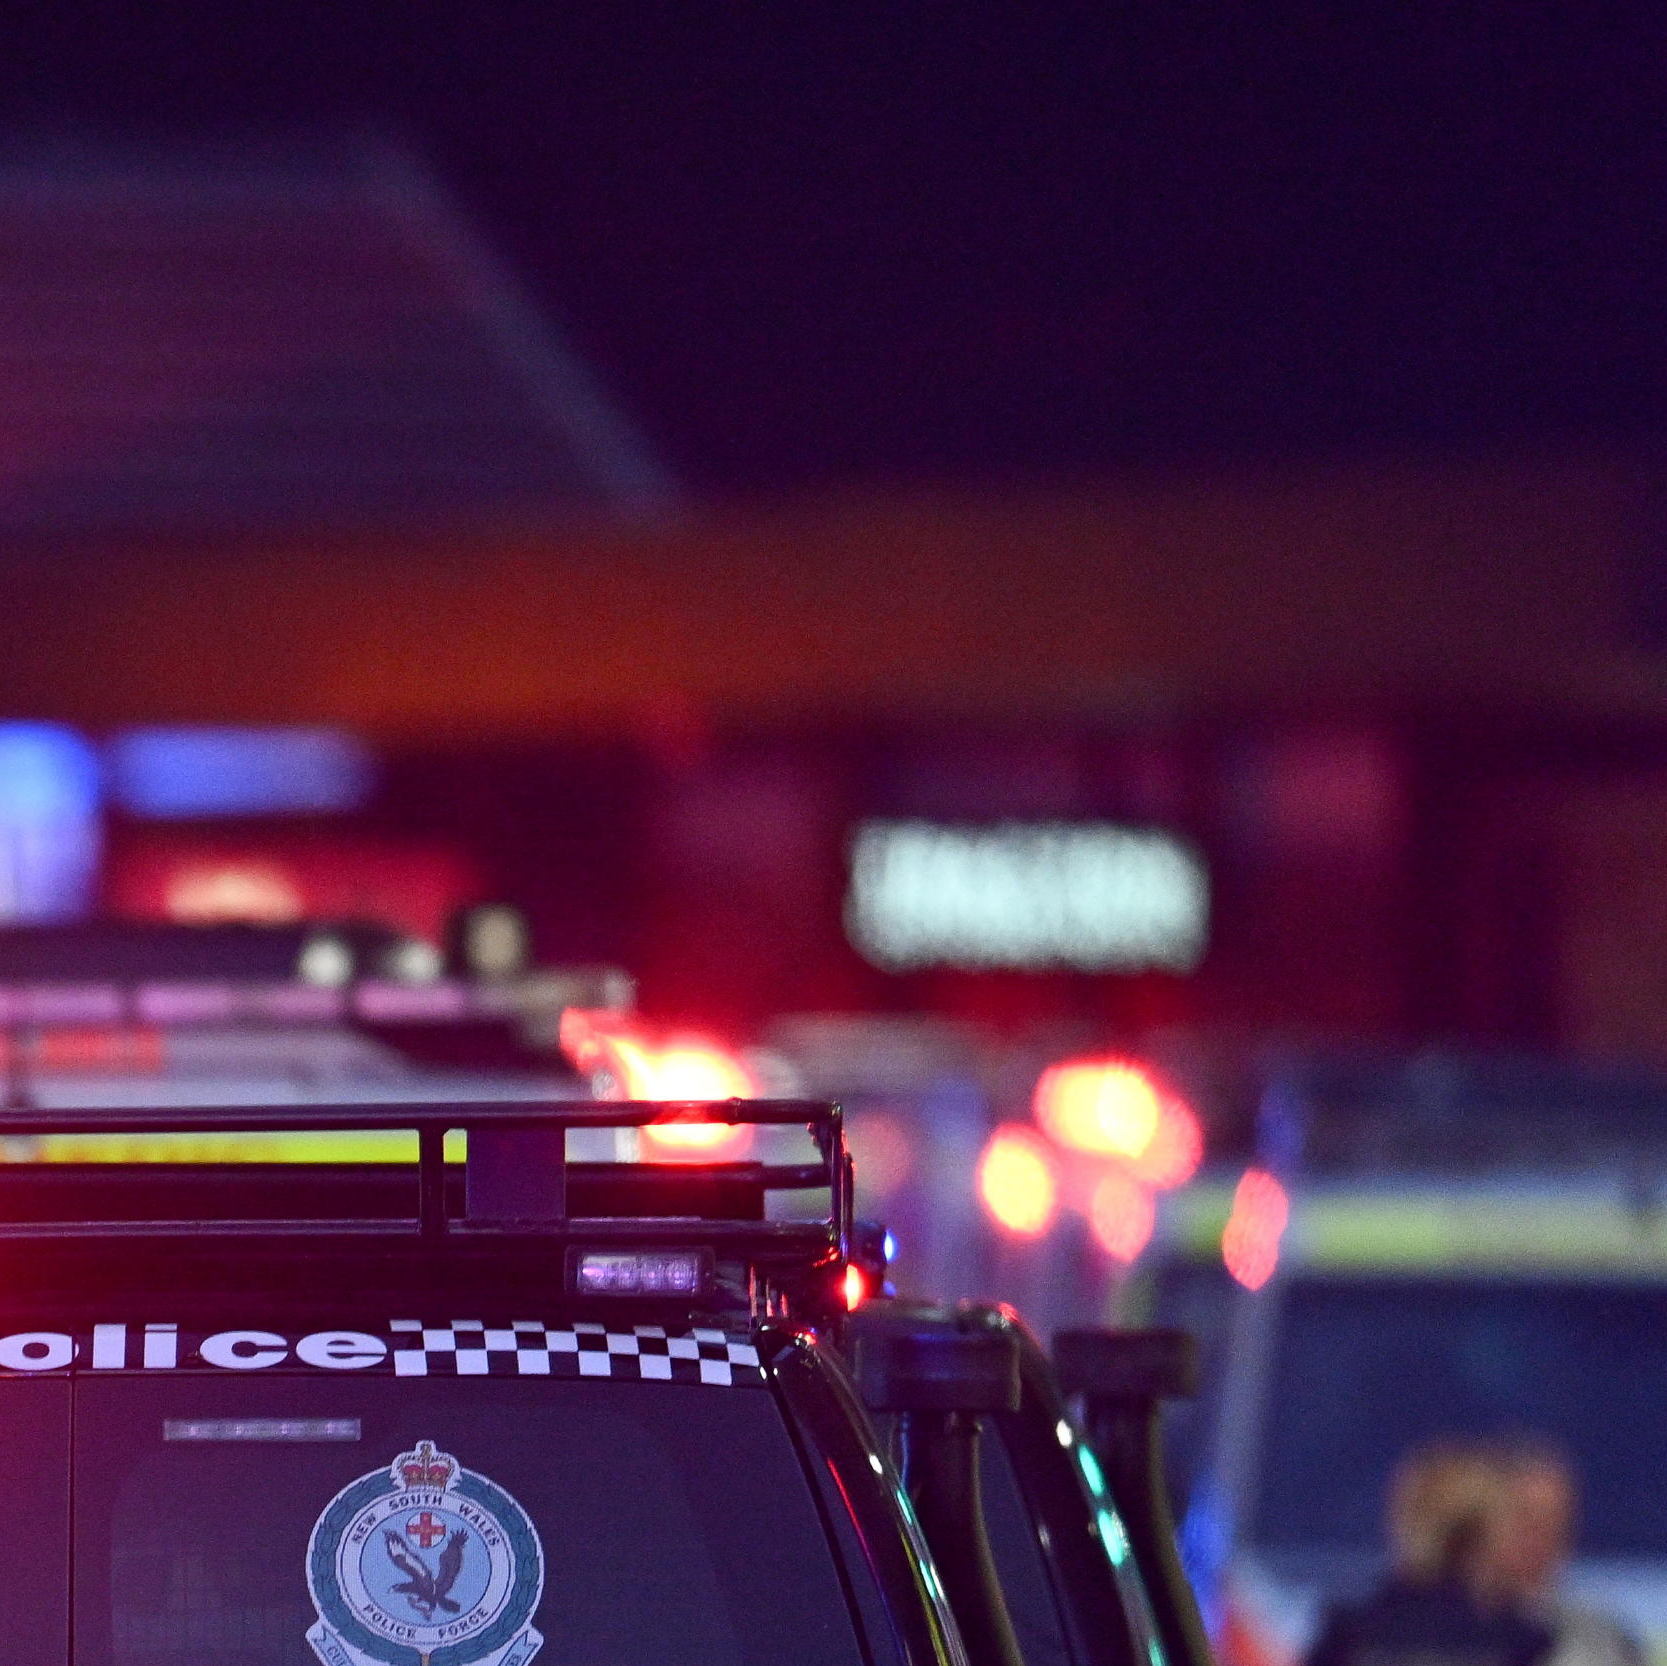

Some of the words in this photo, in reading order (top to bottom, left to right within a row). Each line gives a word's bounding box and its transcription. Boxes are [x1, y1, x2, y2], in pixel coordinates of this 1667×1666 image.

[351, 1512, 377, 1544] NEW
[388, 1495, 443, 1511] SOUTH
[458, 1502, 501, 1547] WALES
[363, 1603, 417, 1640] POLICE
[437, 1606, 490, 1640] FORCE
